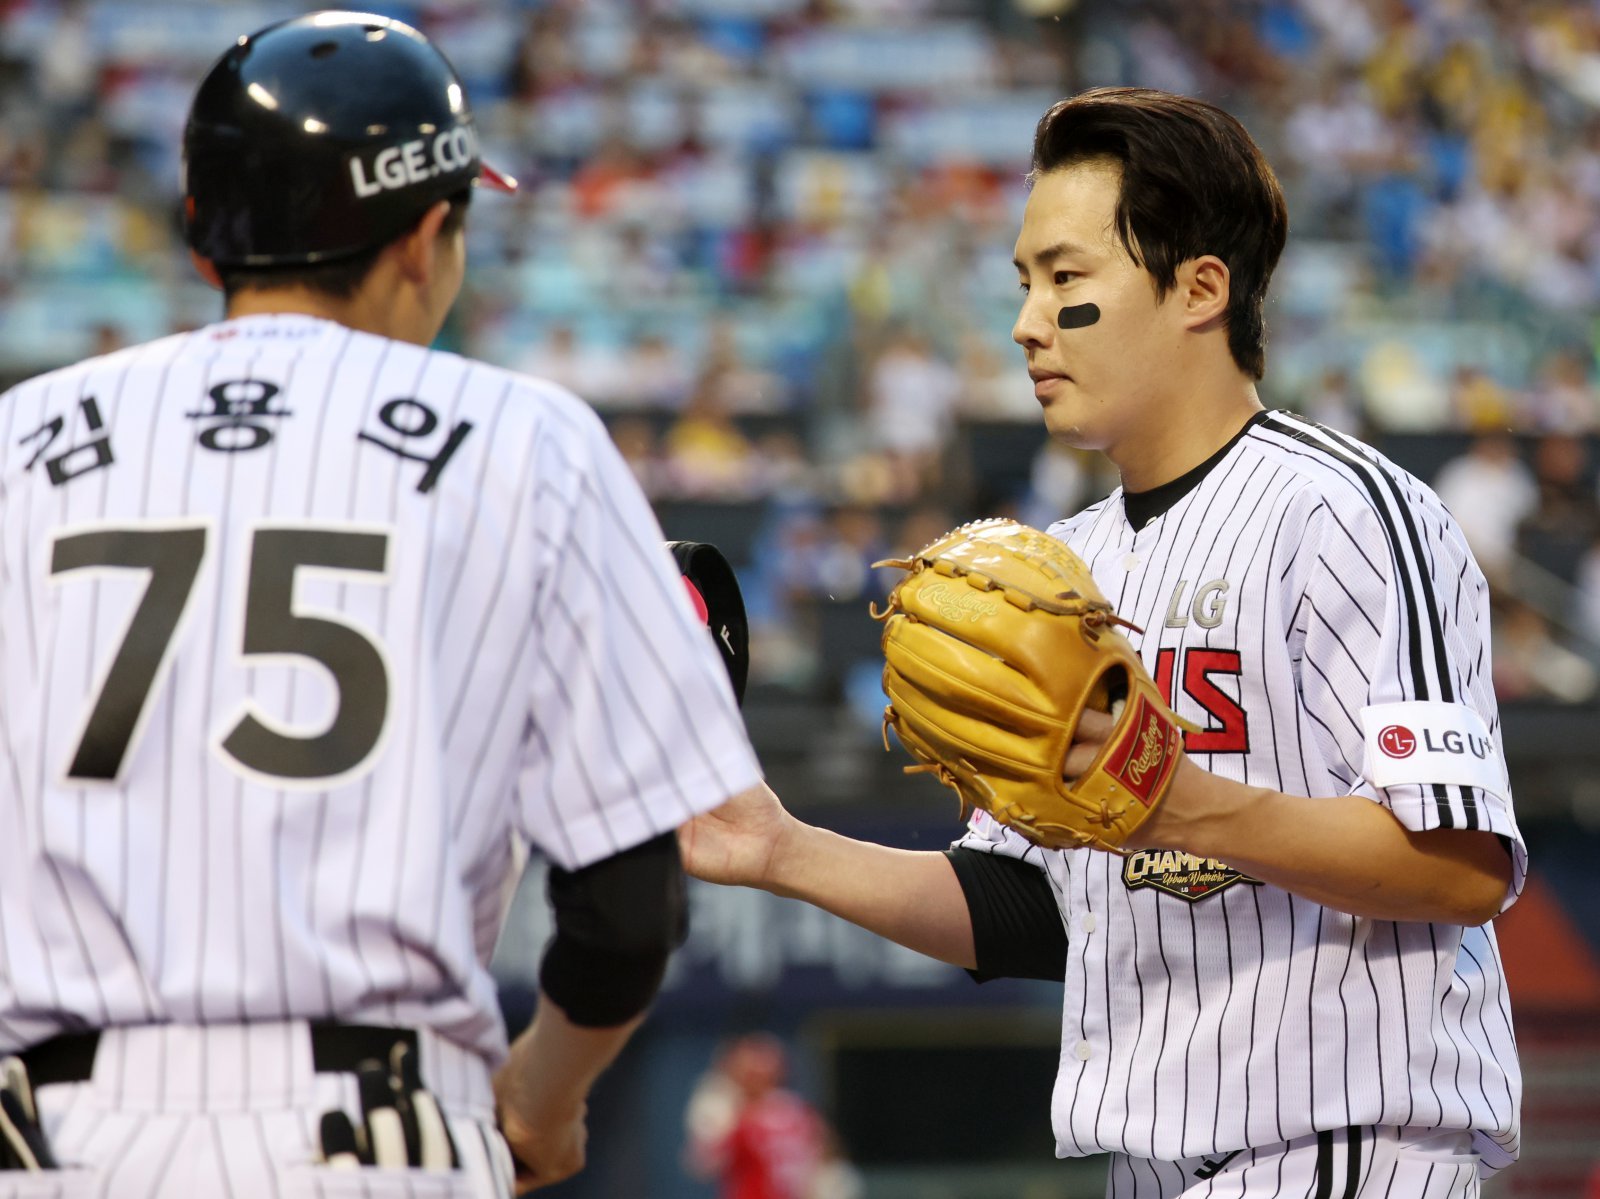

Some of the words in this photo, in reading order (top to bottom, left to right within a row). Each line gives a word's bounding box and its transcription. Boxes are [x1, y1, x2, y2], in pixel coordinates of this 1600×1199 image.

[918, 583, 998, 622] Rawlings
[1165, 579, 1229, 629] LG
[48, 520, 393, 785] 75
[1128, 713, 1163, 785] Rawlings
[1423, 728, 1465, 755] LG
[1162, 872, 1188, 886] Urban
[1188, 870, 1225, 886] Warriors
